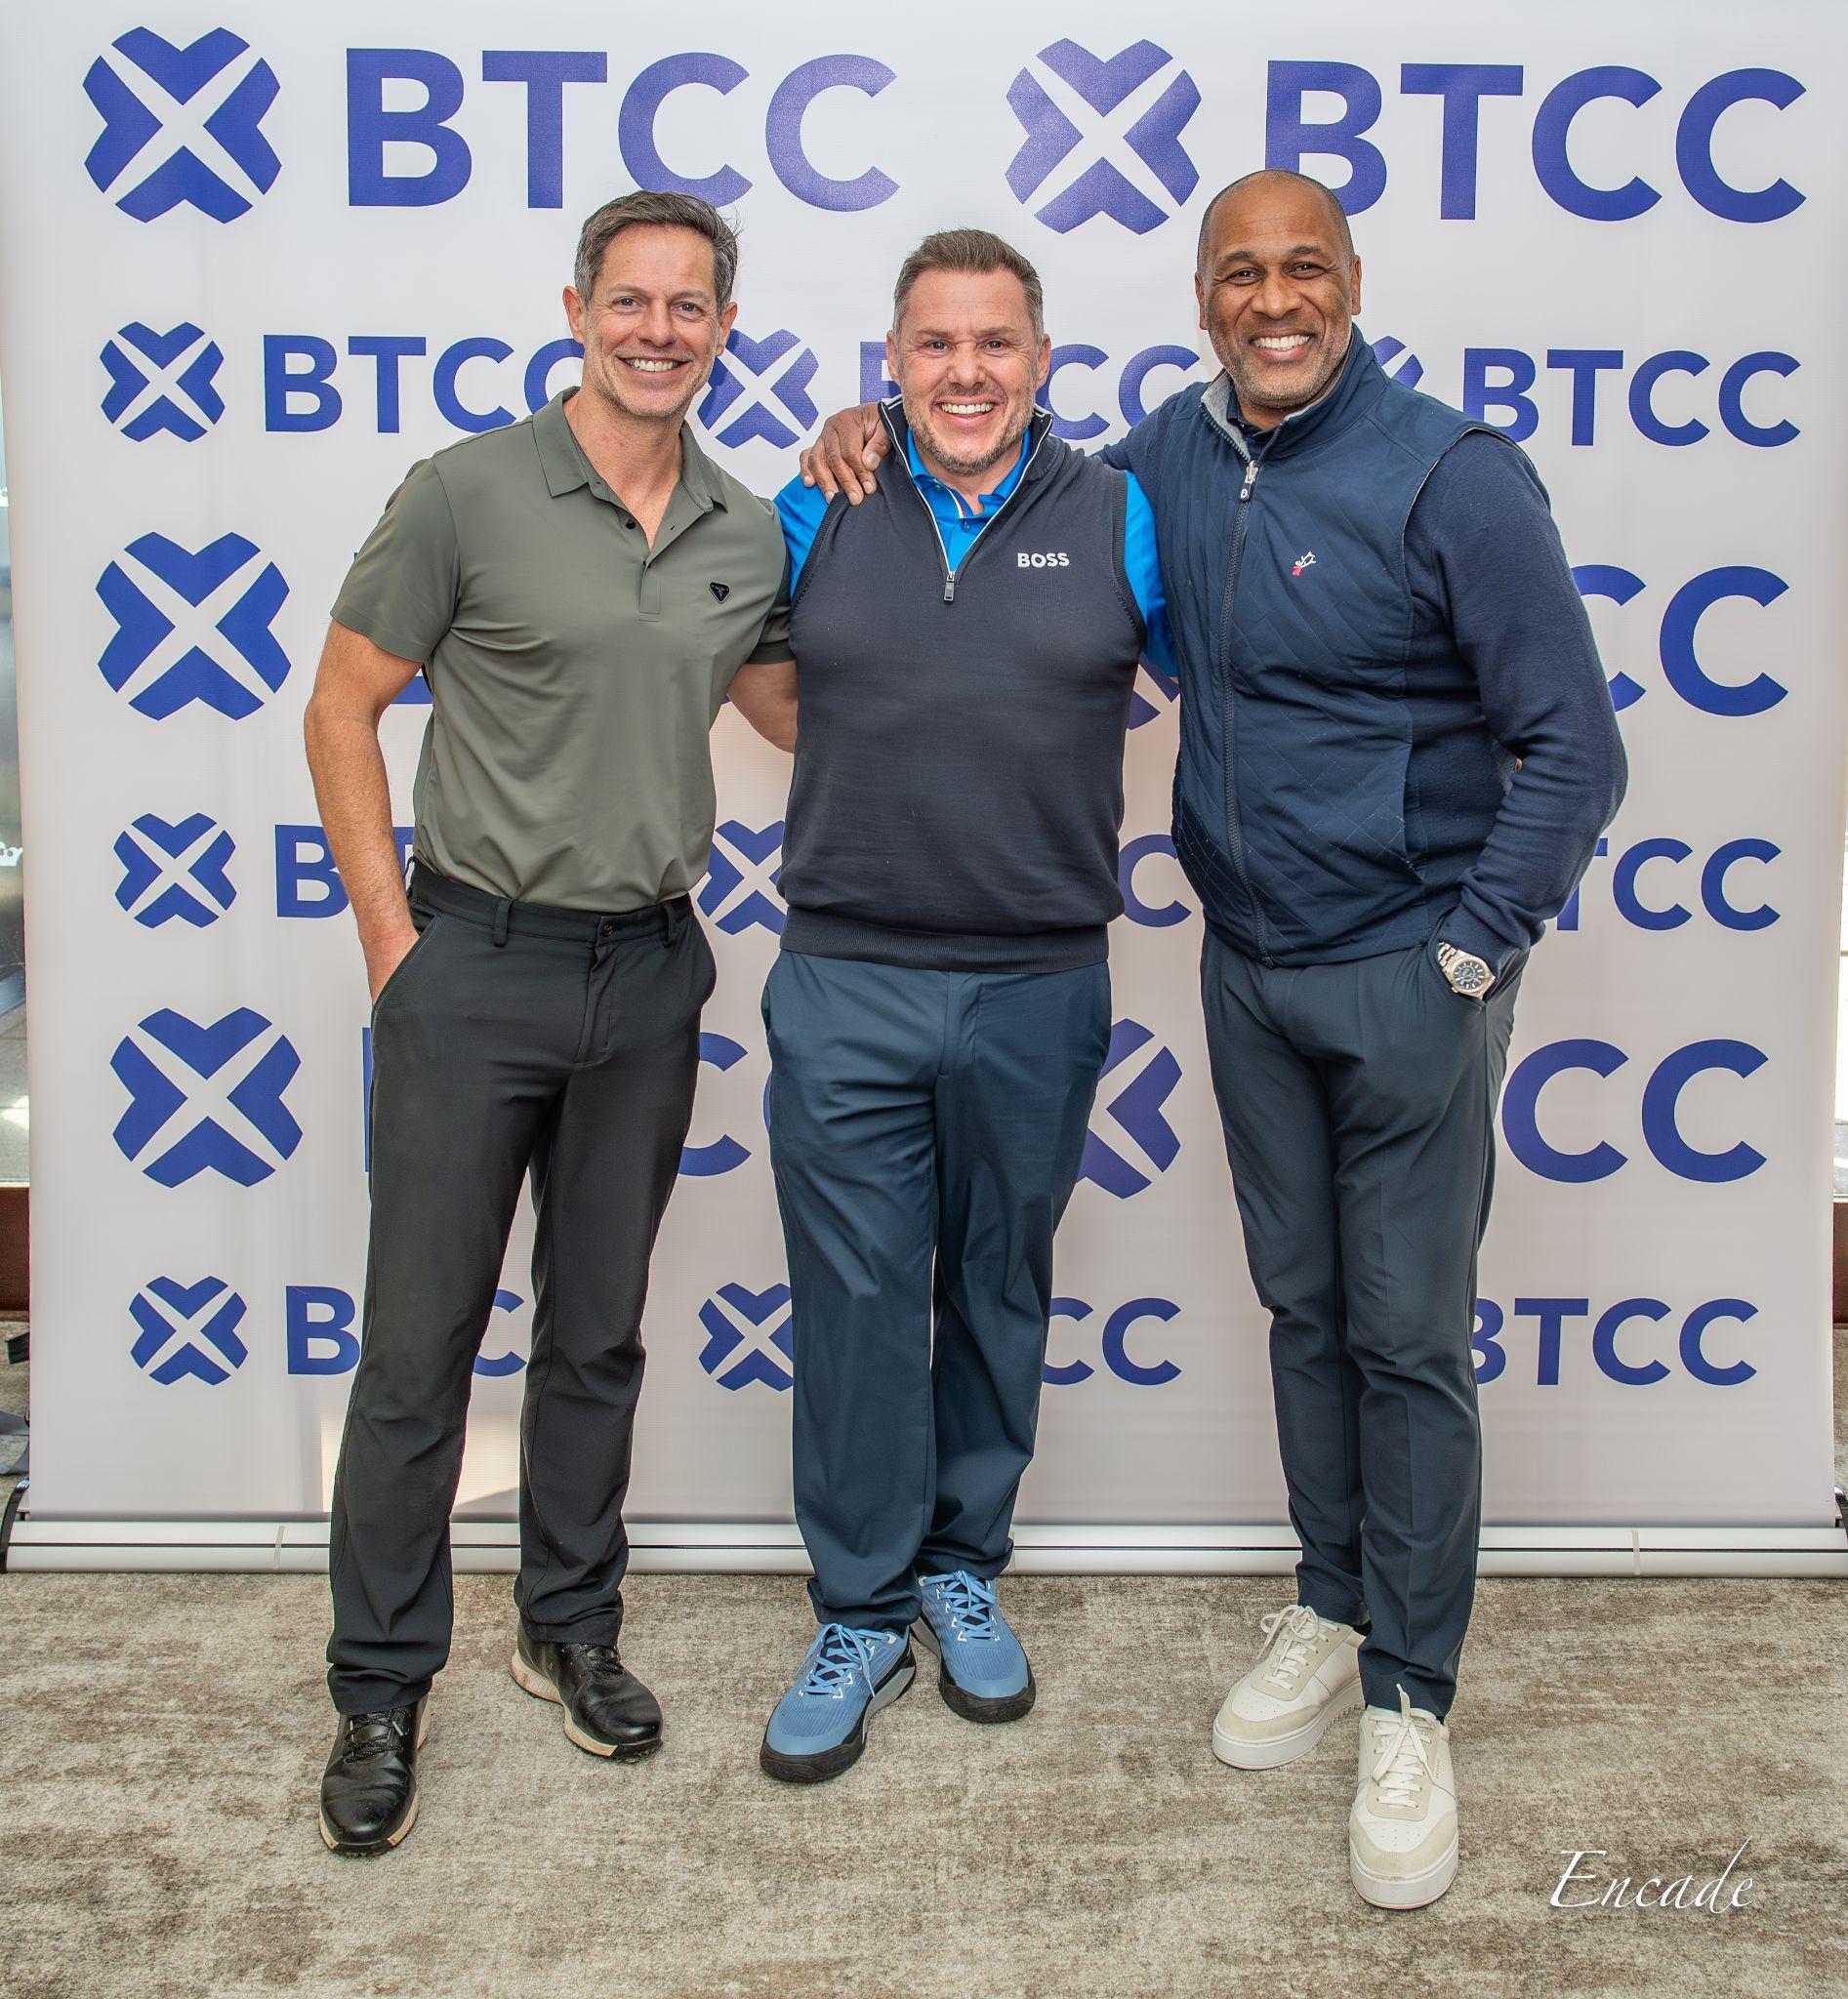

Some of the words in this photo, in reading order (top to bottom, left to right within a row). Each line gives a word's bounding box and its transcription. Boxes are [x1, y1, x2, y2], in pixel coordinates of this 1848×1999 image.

[347, 47, 900, 212] BTCC
[1265, 60, 1807, 224] BTCC
[1463, 347, 1801, 447] BTCC
[1017, 551, 1070, 568] BOSS
